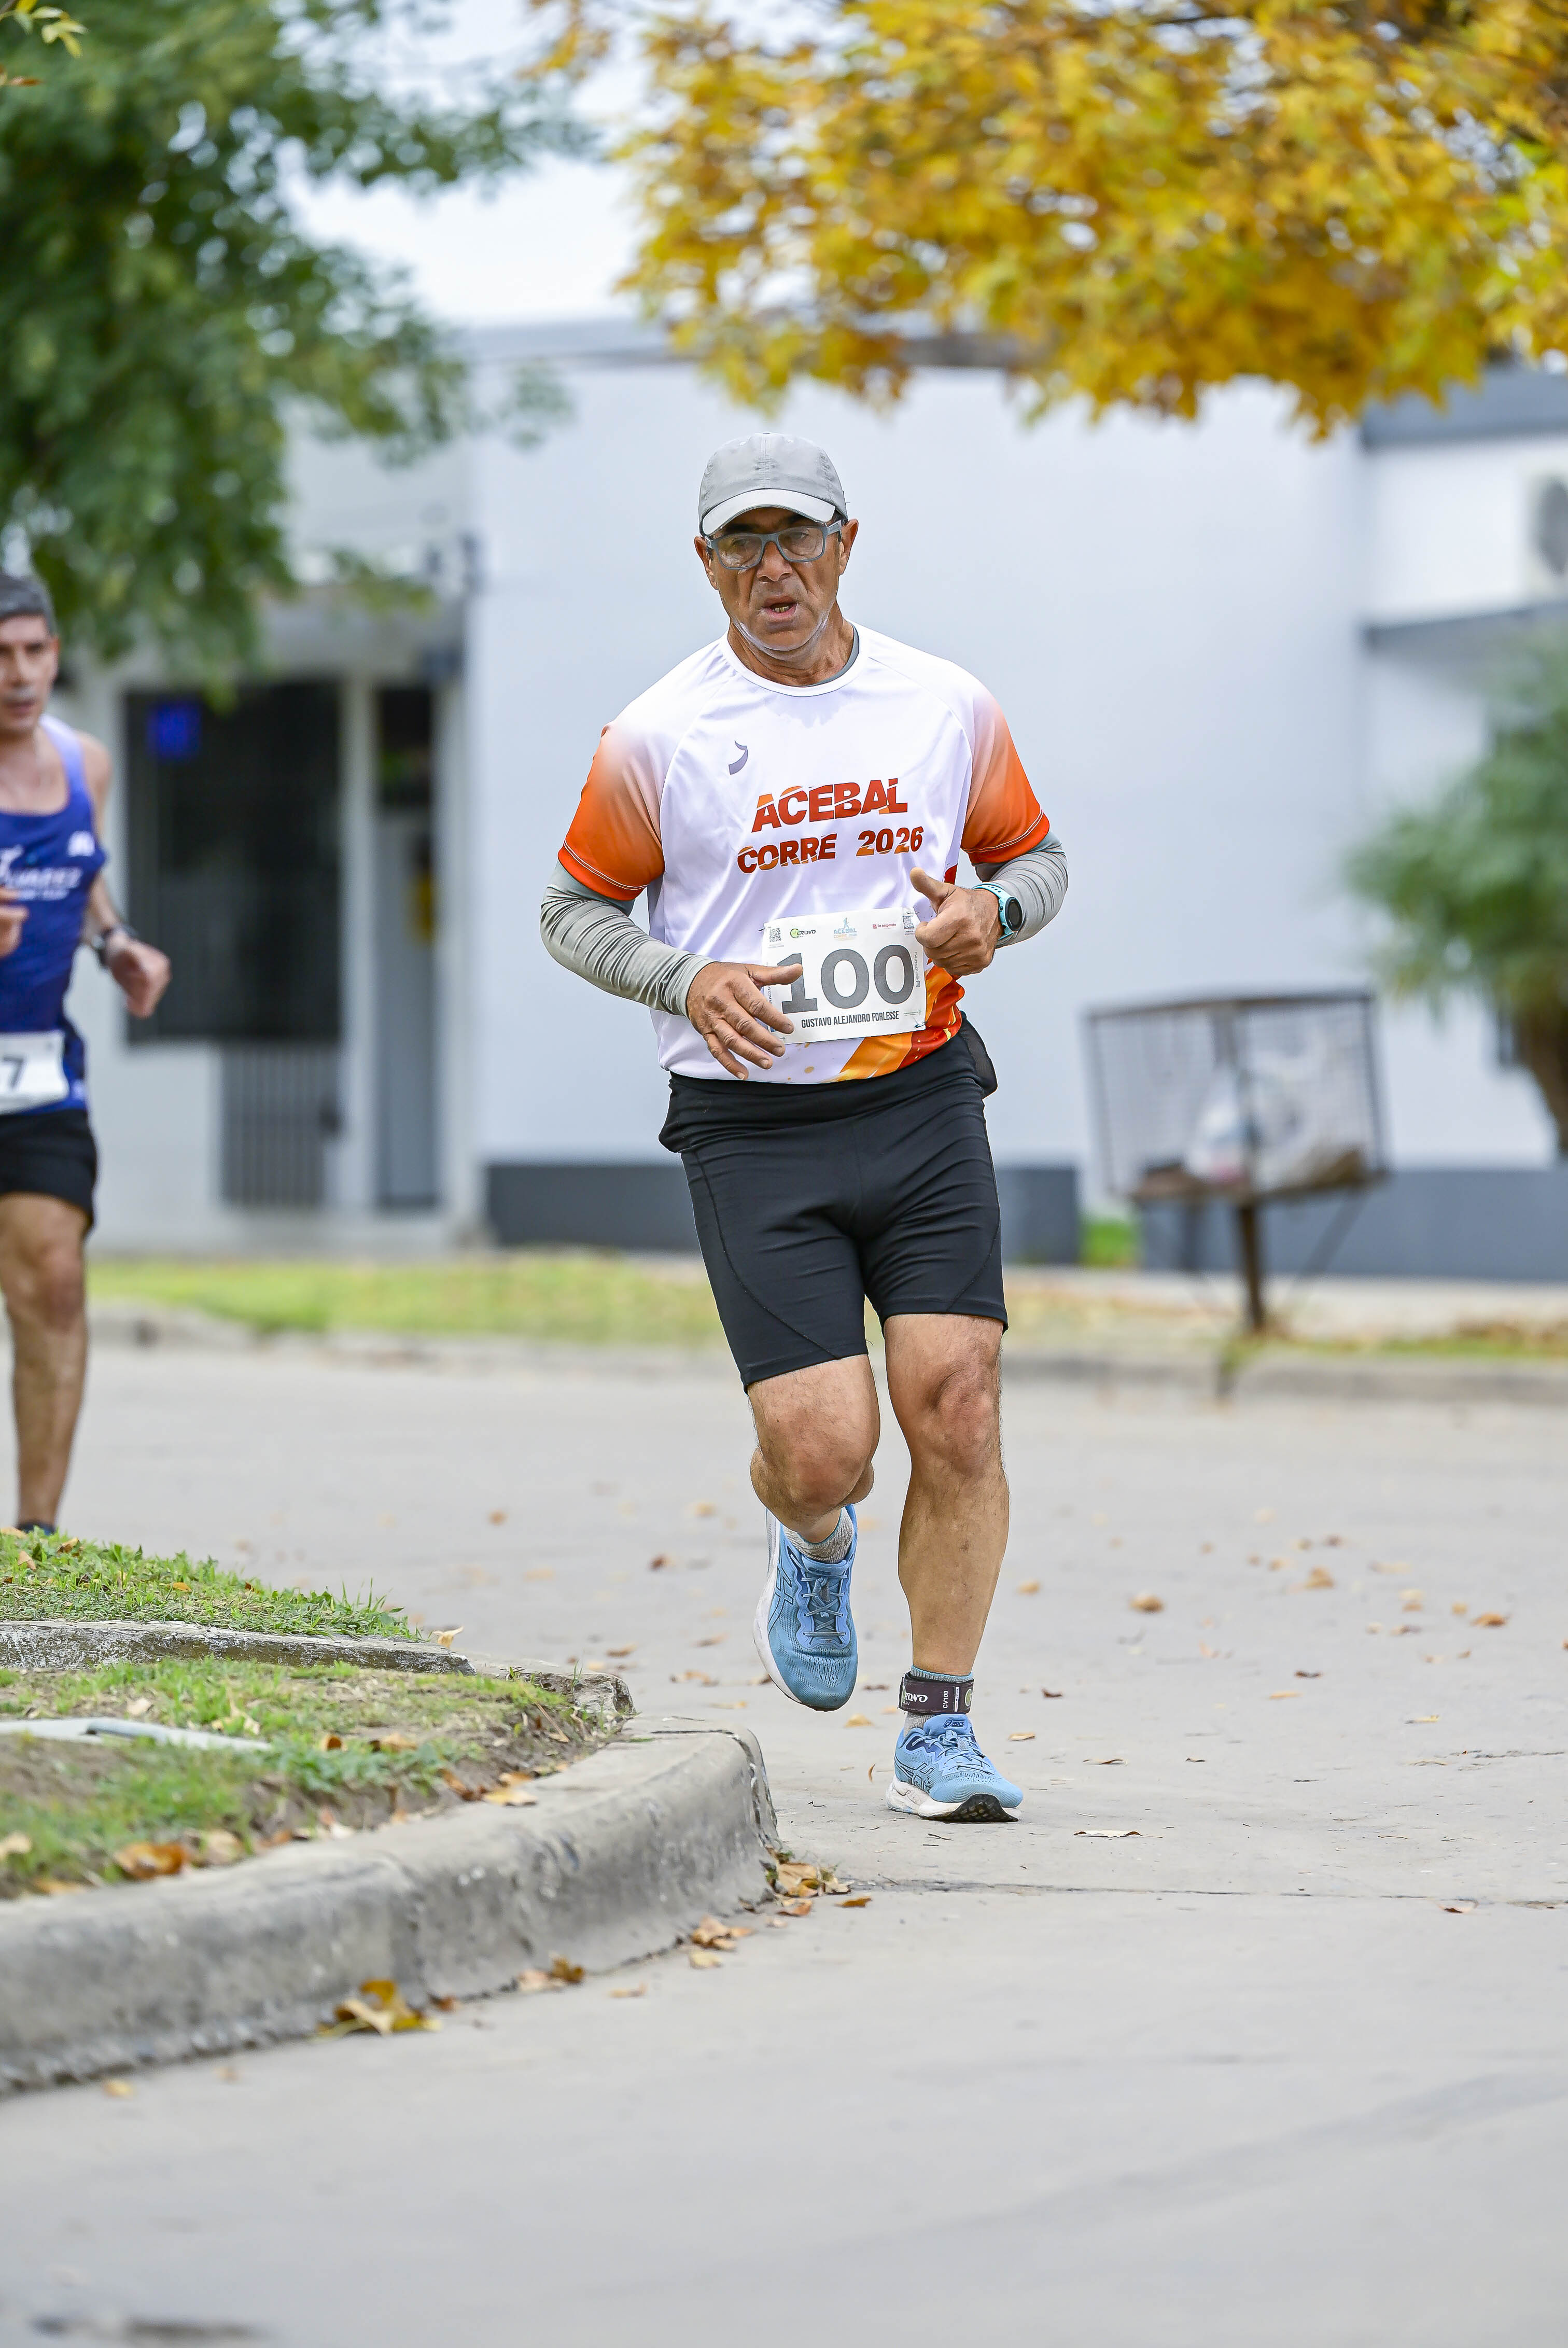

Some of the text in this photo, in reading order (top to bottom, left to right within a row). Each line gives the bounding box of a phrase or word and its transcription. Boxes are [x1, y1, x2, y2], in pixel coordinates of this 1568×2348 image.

[751, 778, 908, 832] ACEBAL
[737, 826, 924, 873] CORRE 2026
[777, 944, 914, 1014] 100
[801, 1017, 832, 1028] GUSTAVO
[833, 1013, 871, 1025] ALEJANDRO
[872, 1011, 899, 1022] FORLESSE
[905, 1693, 928, 1703] RONO
